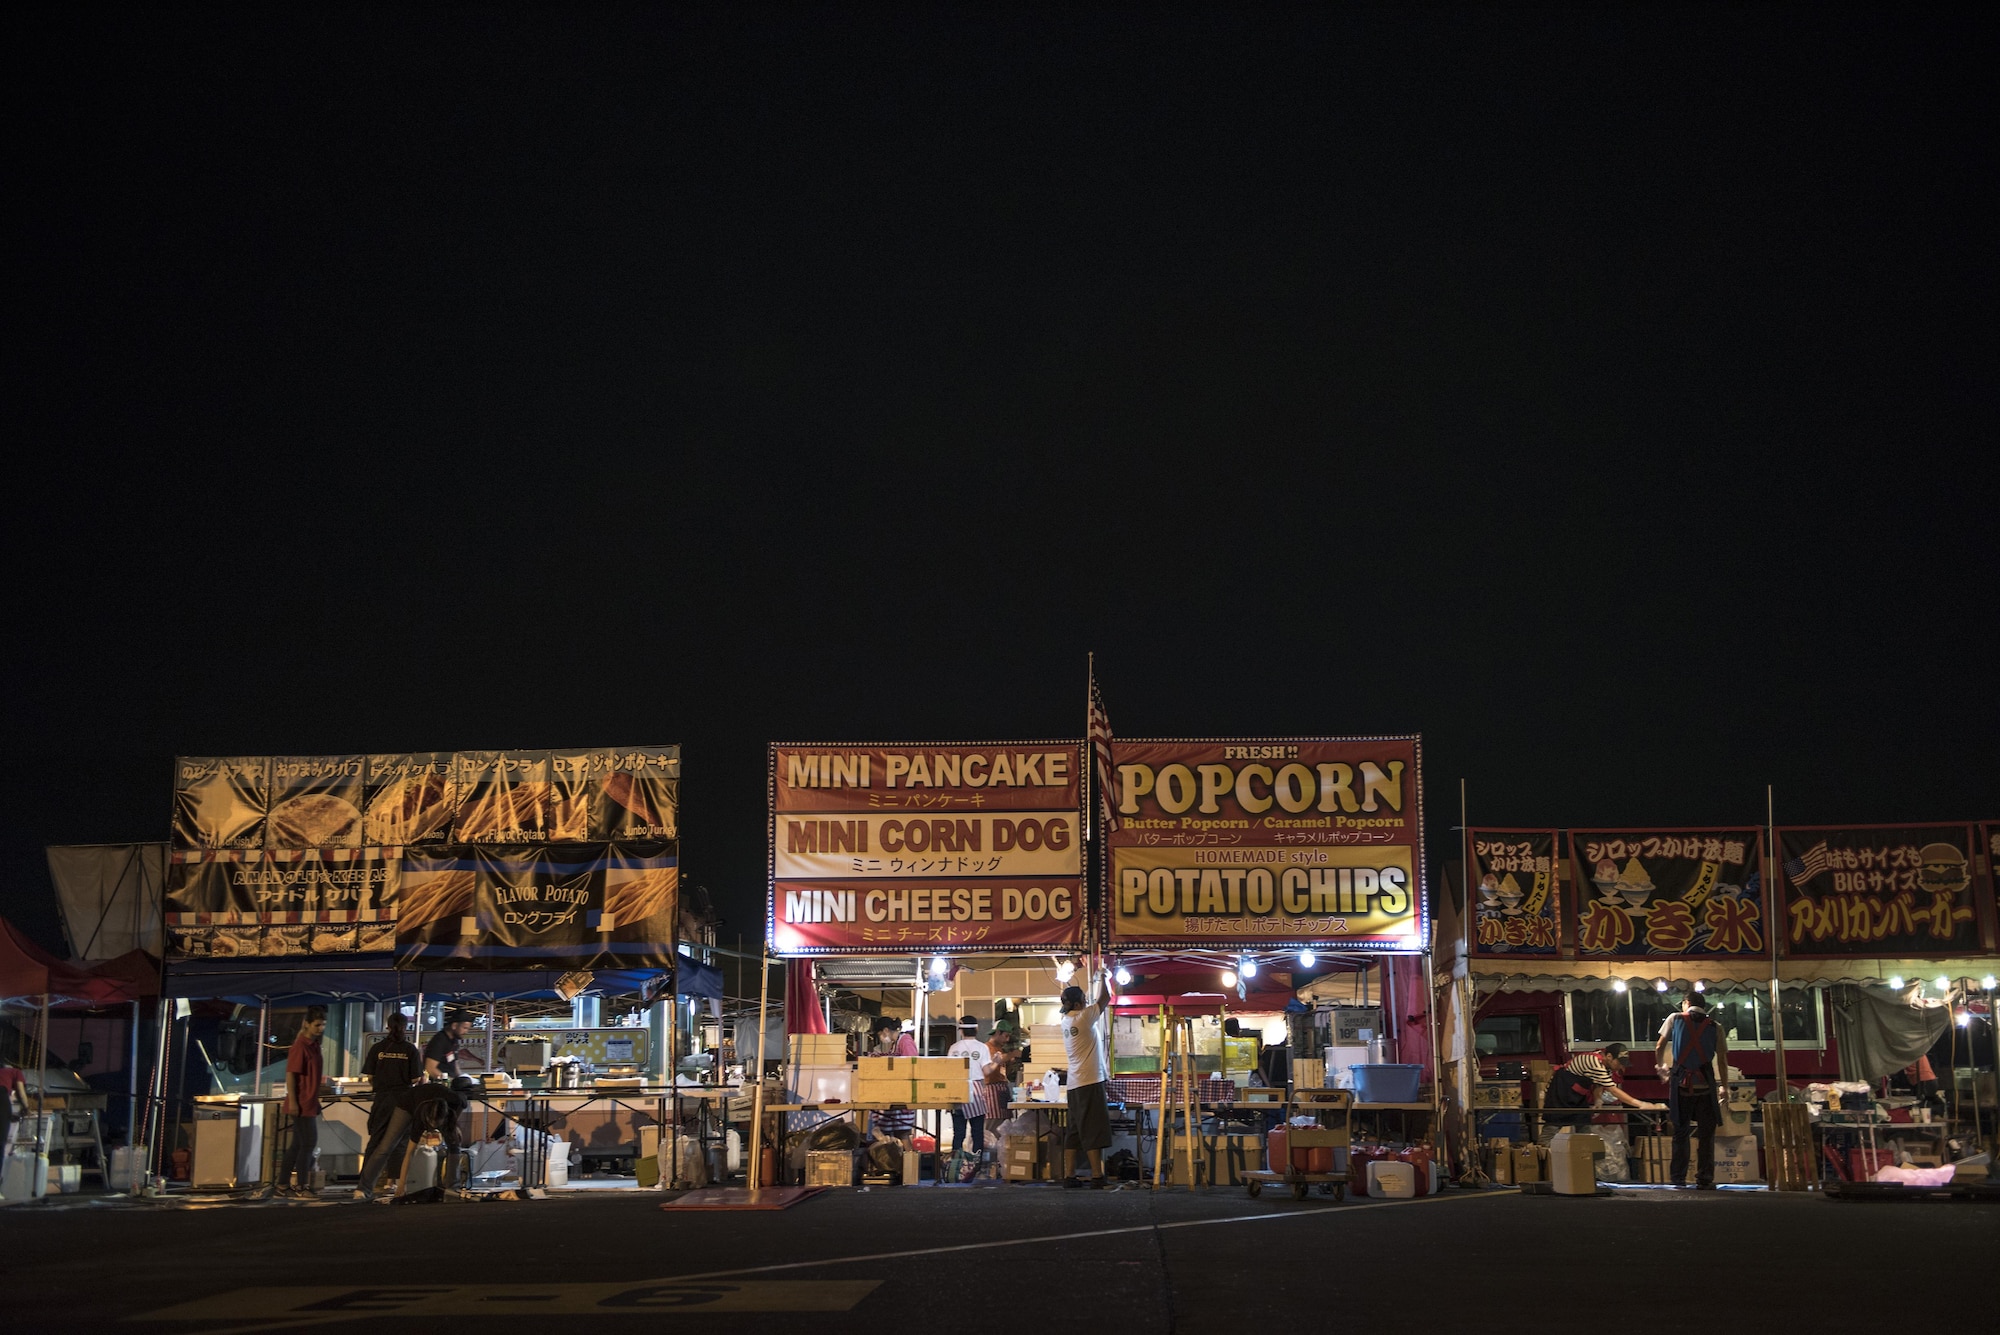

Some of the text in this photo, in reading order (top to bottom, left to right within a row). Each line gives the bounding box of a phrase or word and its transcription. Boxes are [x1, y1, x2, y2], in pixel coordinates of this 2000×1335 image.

[277, 759, 362, 778] おつまみケバブ
[463, 758, 546, 773] ロングフライ
[593, 753, 678, 771] ジャンボターキー
[787, 752, 1069, 788] MINI PANCAKE
[1117, 760, 1405, 815] POPCORN
[868, 793, 985, 808] ミニ パンケーキ
[649, 824, 677, 838] Turkey
[1123, 817, 1178, 829] Butter
[1181, 817, 1249, 831] Popcorn
[1264, 816, 1331, 829] Caramel
[1335, 815, 1405, 830] Popcorn
[517, 829, 546, 841] Potato
[787, 818, 1070, 854] MINI CORN DOG
[1137, 833, 1242, 845] バターポップコーン
[1274, 832, 1395, 844] キャラメルポップコーン
[1475, 840, 1533, 855] シロップ
[1585, 837, 1745, 866] シロップかけ放題
[852, 856, 1002, 872] ミニ ウィンナドッグ
[1195, 849, 1328, 866] HOMEMADE style
[1490, 856, 1551, 873] かけ放題
[1826, 846, 1922, 868] 味もサイズも
[256, 884, 375, 903] アナドル ケバブ
[495, 884, 589, 905] FLAVOR POTATO
[1121, 866, 1408, 915] POTATO CHIPS
[785, 887, 1072, 924] MINI CHEESE DOG
[504, 910, 577, 925] ロングフライ
[1579, 898, 1764, 951] かき氷
[1790, 892, 1973, 943] アメリカンバーガー
[862, 926, 990, 942] ミニ チーズドッグ
[1477, 916, 1555, 947] かき氷
